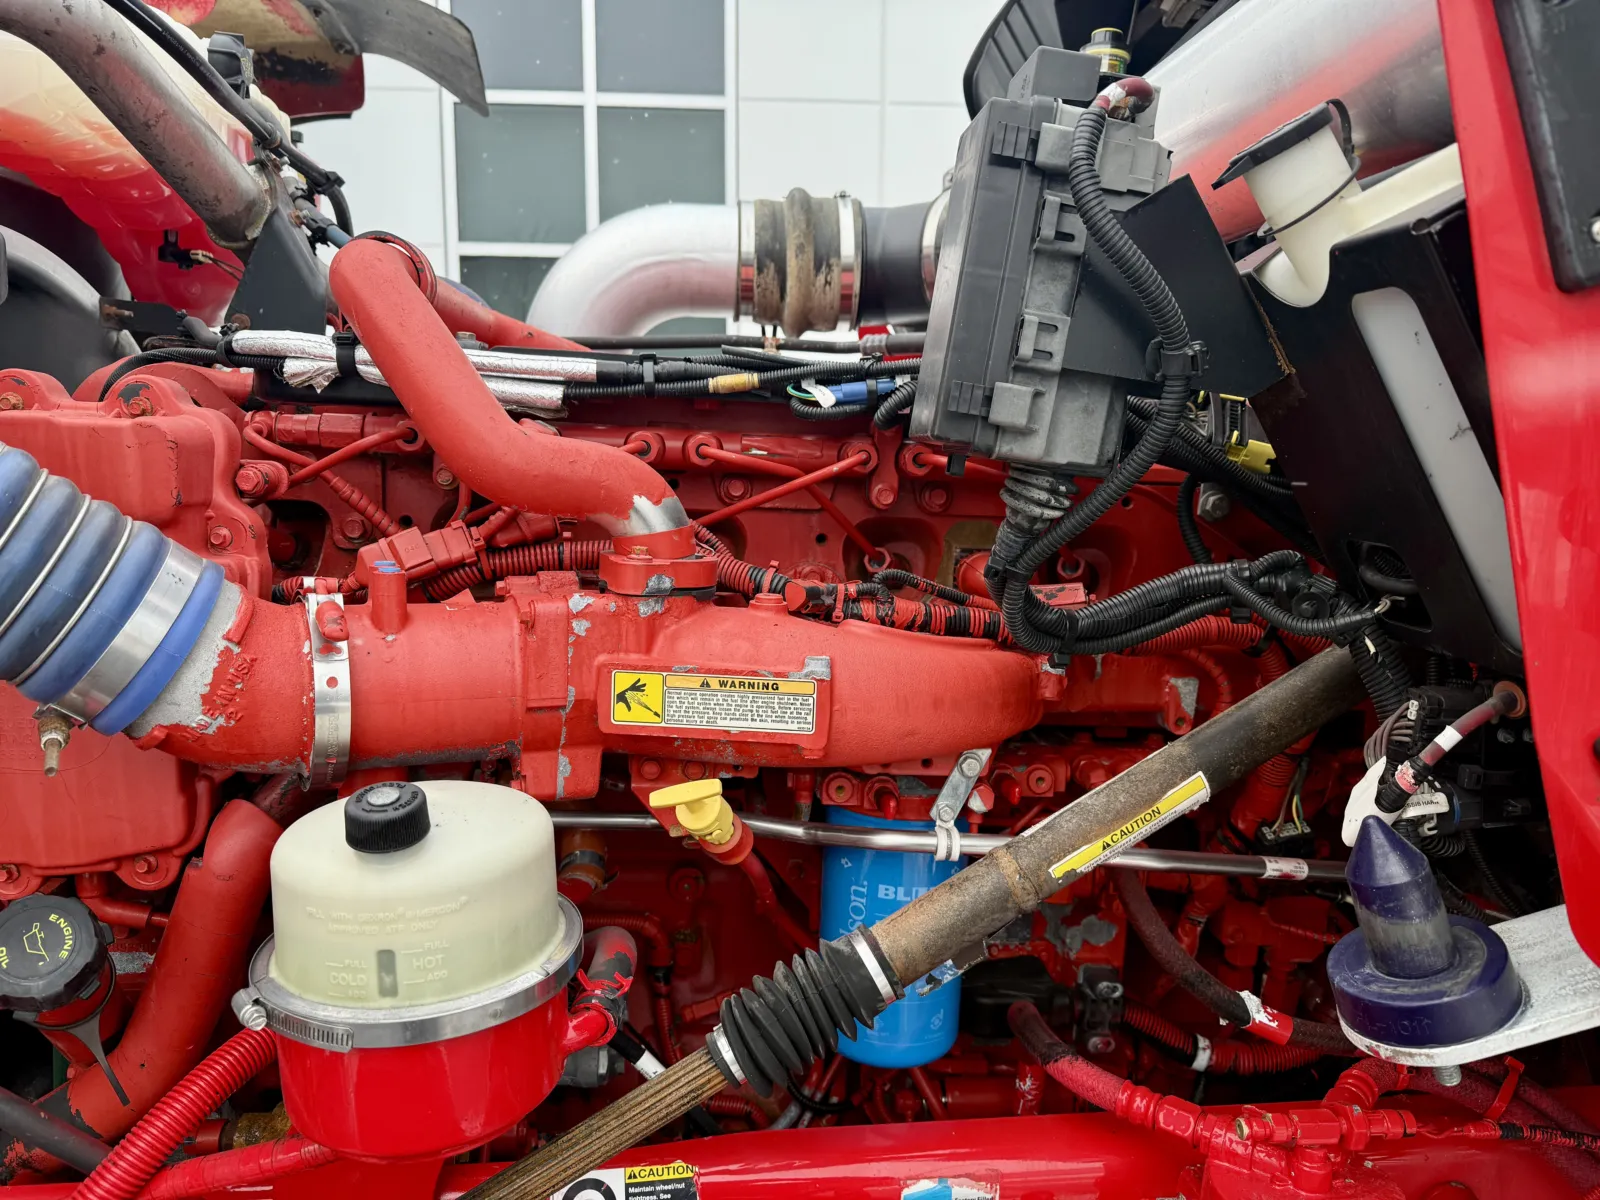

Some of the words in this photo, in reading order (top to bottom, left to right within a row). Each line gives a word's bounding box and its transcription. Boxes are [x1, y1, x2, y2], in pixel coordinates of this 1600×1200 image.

[718, 679, 780, 691] WARNING
[1110, 806, 1161, 844] CAUTION
[386, 924, 405, 935] ATF
[411, 920, 438, 932] ONLY
[48, 913, 73, 959] ENGINE
[424, 940, 449, 951] FULL
[345, 959, 368, 968] FULL
[413, 954, 445, 970] HOT
[330, 972, 368, 986] COLD
[427, 970, 448, 981] ADD
[638, 1164, 694, 1179] CAUTION
[628, 1185, 654, 1193] Maintain
[655, 1182, 685, 1190] wheel/nut
